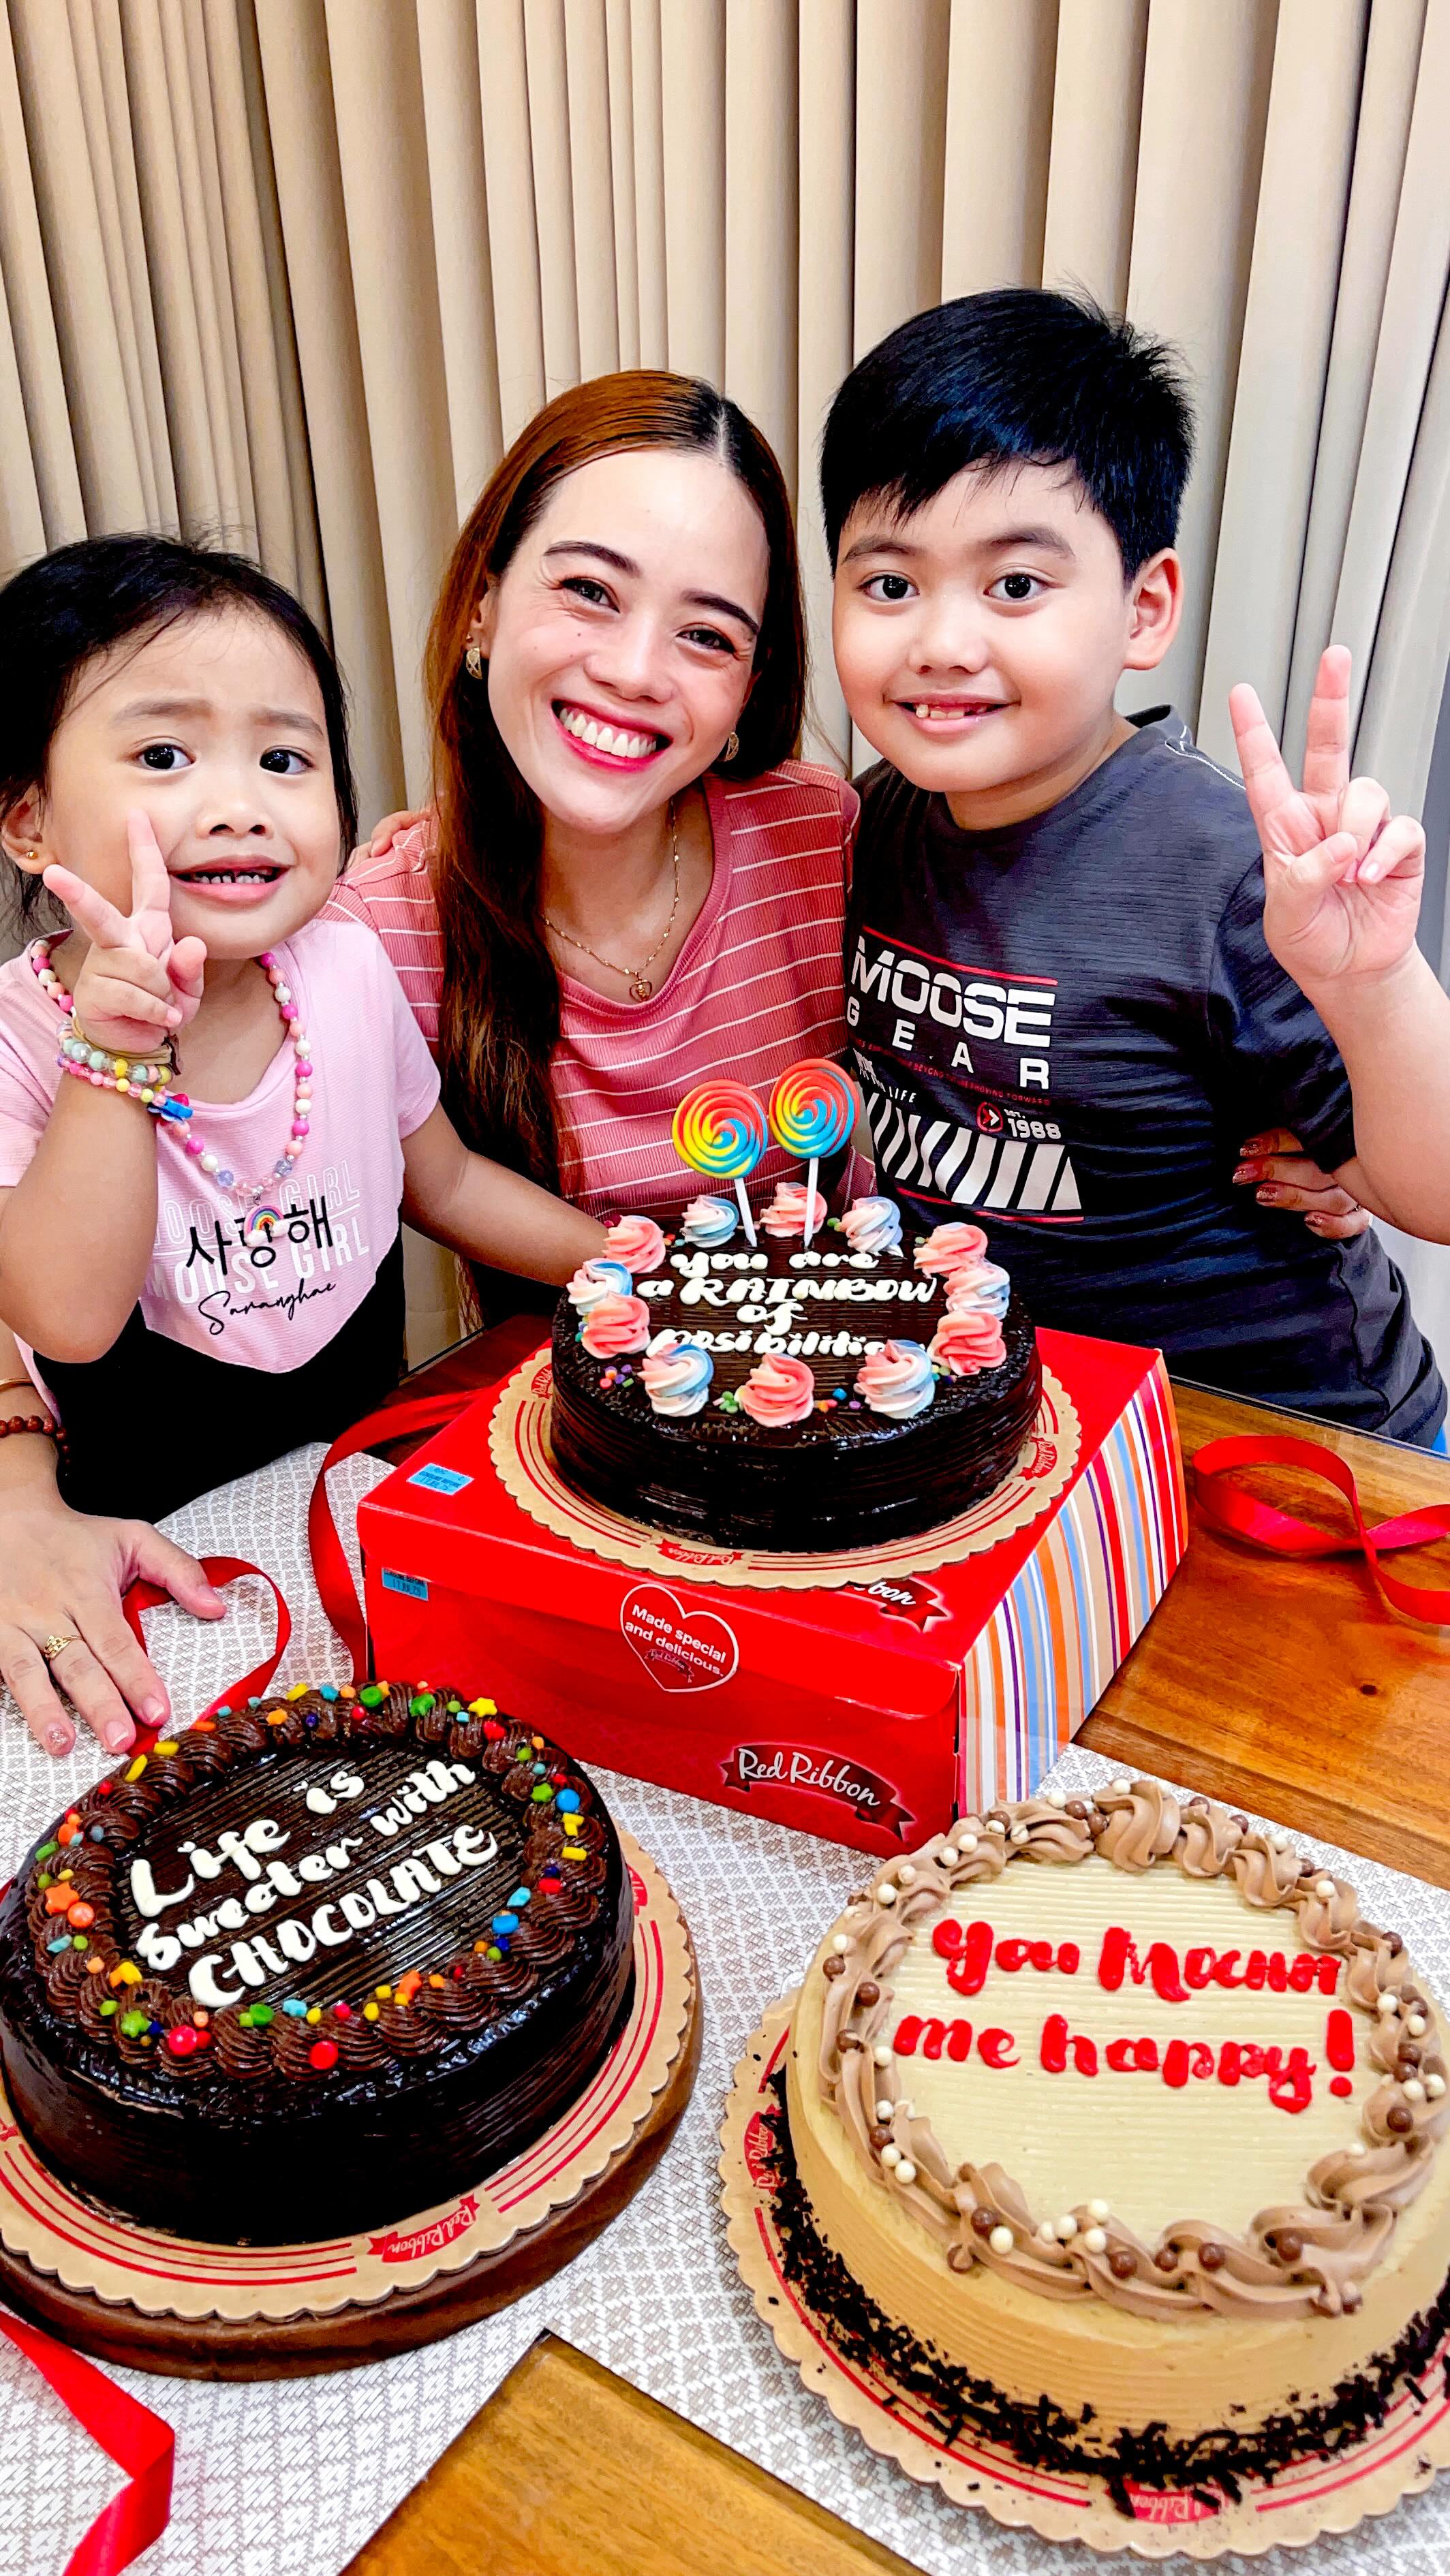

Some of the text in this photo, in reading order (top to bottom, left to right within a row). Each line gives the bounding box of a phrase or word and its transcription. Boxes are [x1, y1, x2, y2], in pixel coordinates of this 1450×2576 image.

[851, 935, 1056, 1048] MOOSE
[847, 995, 1050, 1090] GEAR
[889, 1086, 917, 1103] LIFE
[1007, 1117, 1062, 1140] 1988
[279, 1160, 360, 1213] GIRL
[290, 1216, 370, 1279] GIRL
[788, 1251, 879, 1269] are
[636, 1276, 938, 1307] a RAINBOW
[735, 1301, 809, 1336] of
[624, 1621, 724, 1677] and delicious.
[632, 1604, 727, 1664] Made special
[369, 1759, 476, 1836] with
[737, 1747, 881, 1807] Red Ribbon
[130, 1769, 365, 1918] Life is
[188, 1824, 499, 2008] CHOCOLATE
[892, 2008, 1356, 2113] me happy!
[387, 2205, 475, 2258] Red Ribbon
